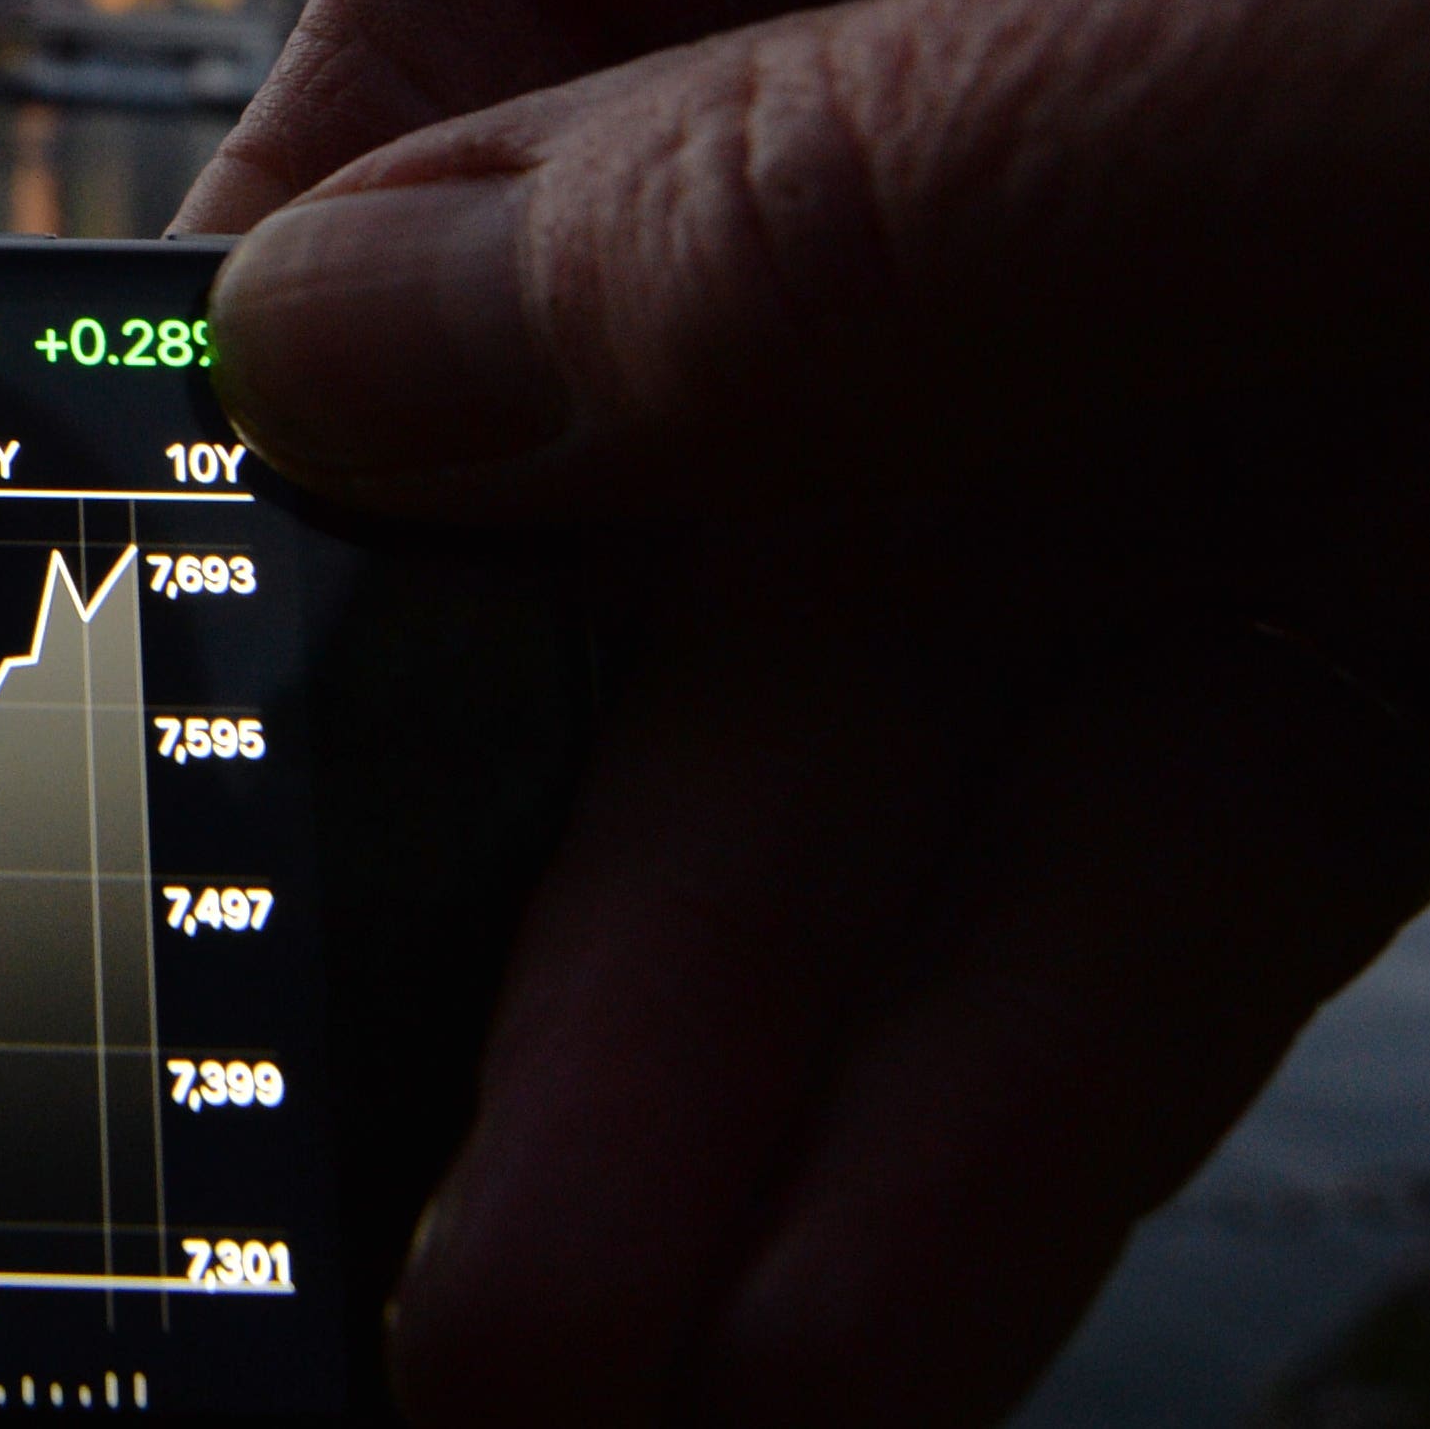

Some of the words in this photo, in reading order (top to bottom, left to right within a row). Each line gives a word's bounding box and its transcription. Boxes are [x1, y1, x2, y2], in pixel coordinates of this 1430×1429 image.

[165, 441, 247, 485] 10Y
[146, 553, 258, 600] 7,693
[154, 716, 267, 765] 7,595
[162, 885, 275, 937] 7,497
[166, 1058, 286, 1113] 7,399
[180, 1236, 292, 1293] 7,301
